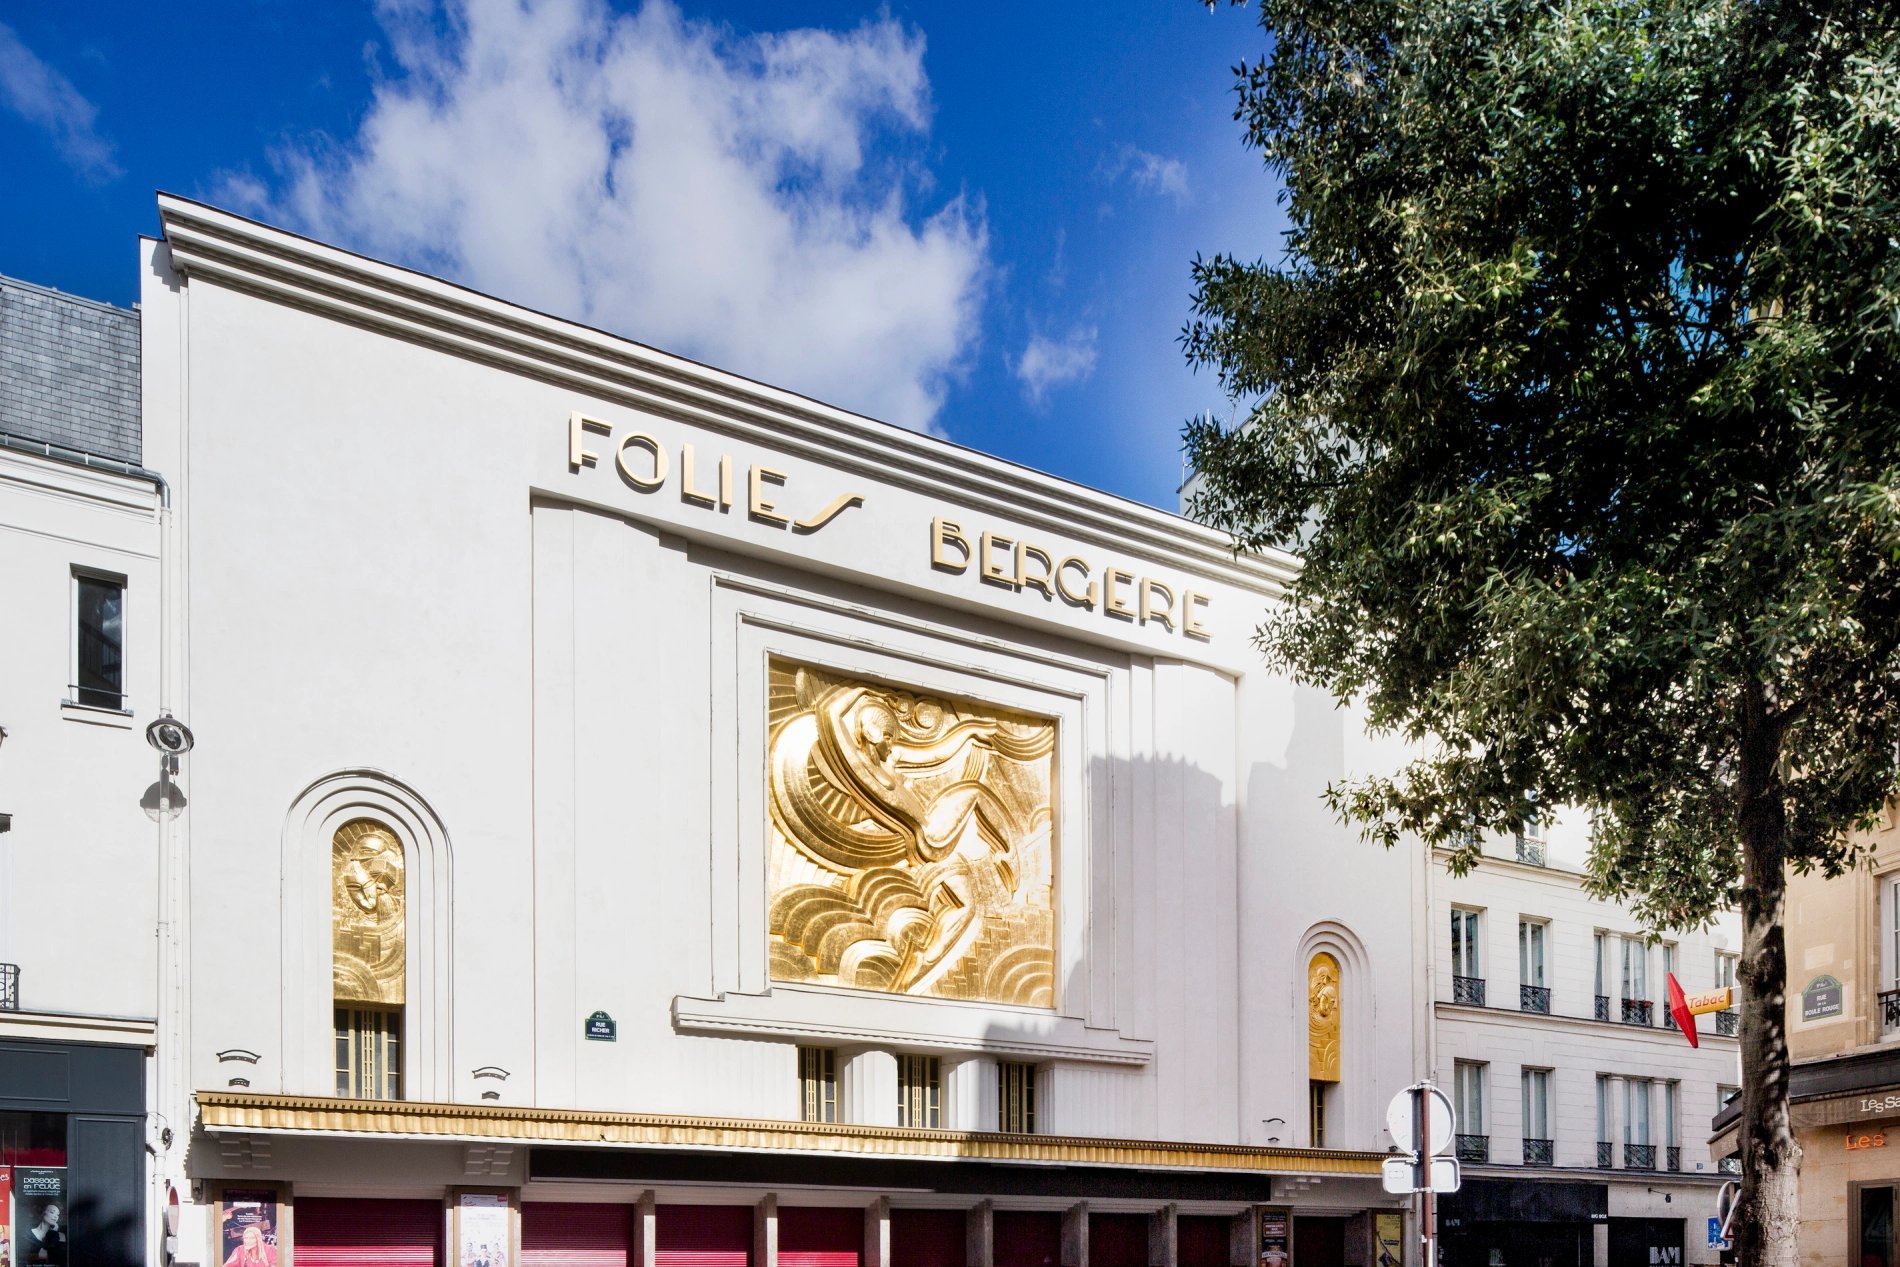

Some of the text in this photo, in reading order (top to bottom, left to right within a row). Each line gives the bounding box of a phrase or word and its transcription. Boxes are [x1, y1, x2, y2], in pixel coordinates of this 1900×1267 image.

[569, 410, 1214, 639] FOLIES BERGERE
[1690, 995, 1725, 1008] Tabac
[1805, 1004, 1840, 1016] BOULE ROUGE
[1860, 1099, 1884, 1113] Les
[1845, 1134, 1884, 1150] Les
[1649, 1246, 1681, 1265] BAM
